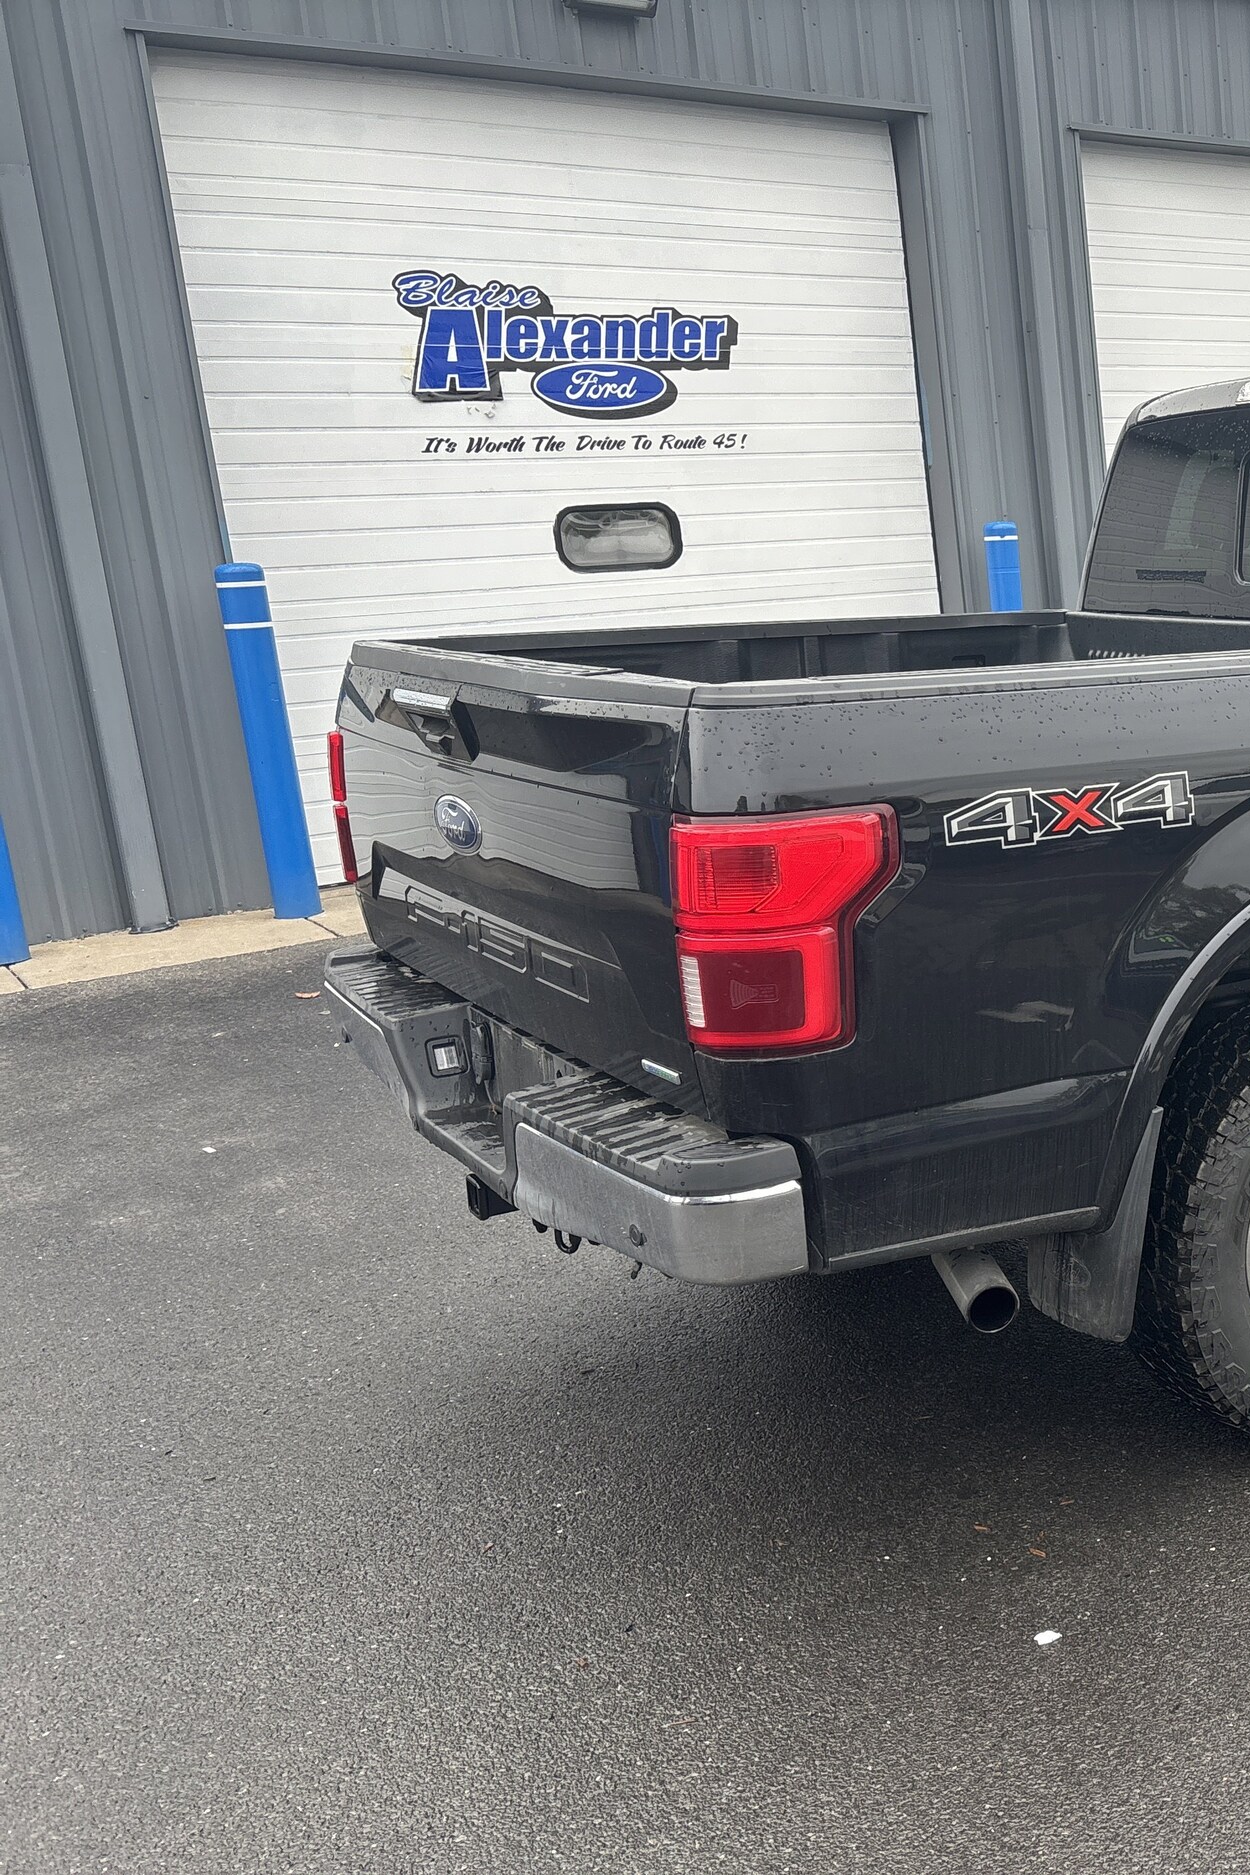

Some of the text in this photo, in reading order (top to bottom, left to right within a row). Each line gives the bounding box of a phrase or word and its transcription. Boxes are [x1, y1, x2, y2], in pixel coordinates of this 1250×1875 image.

[395, 273, 541, 309] Blaise
[414, 305, 730, 393] Alexander
[565, 369, 637, 400] Ford
[421, 436, 457, 453] It's
[465, 435, 525, 453] Worth
[532, 435, 566, 452] The
[576, 434, 626, 452] Drive
[631, 434, 652, 451] To
[659, 433, 707, 451] Route
